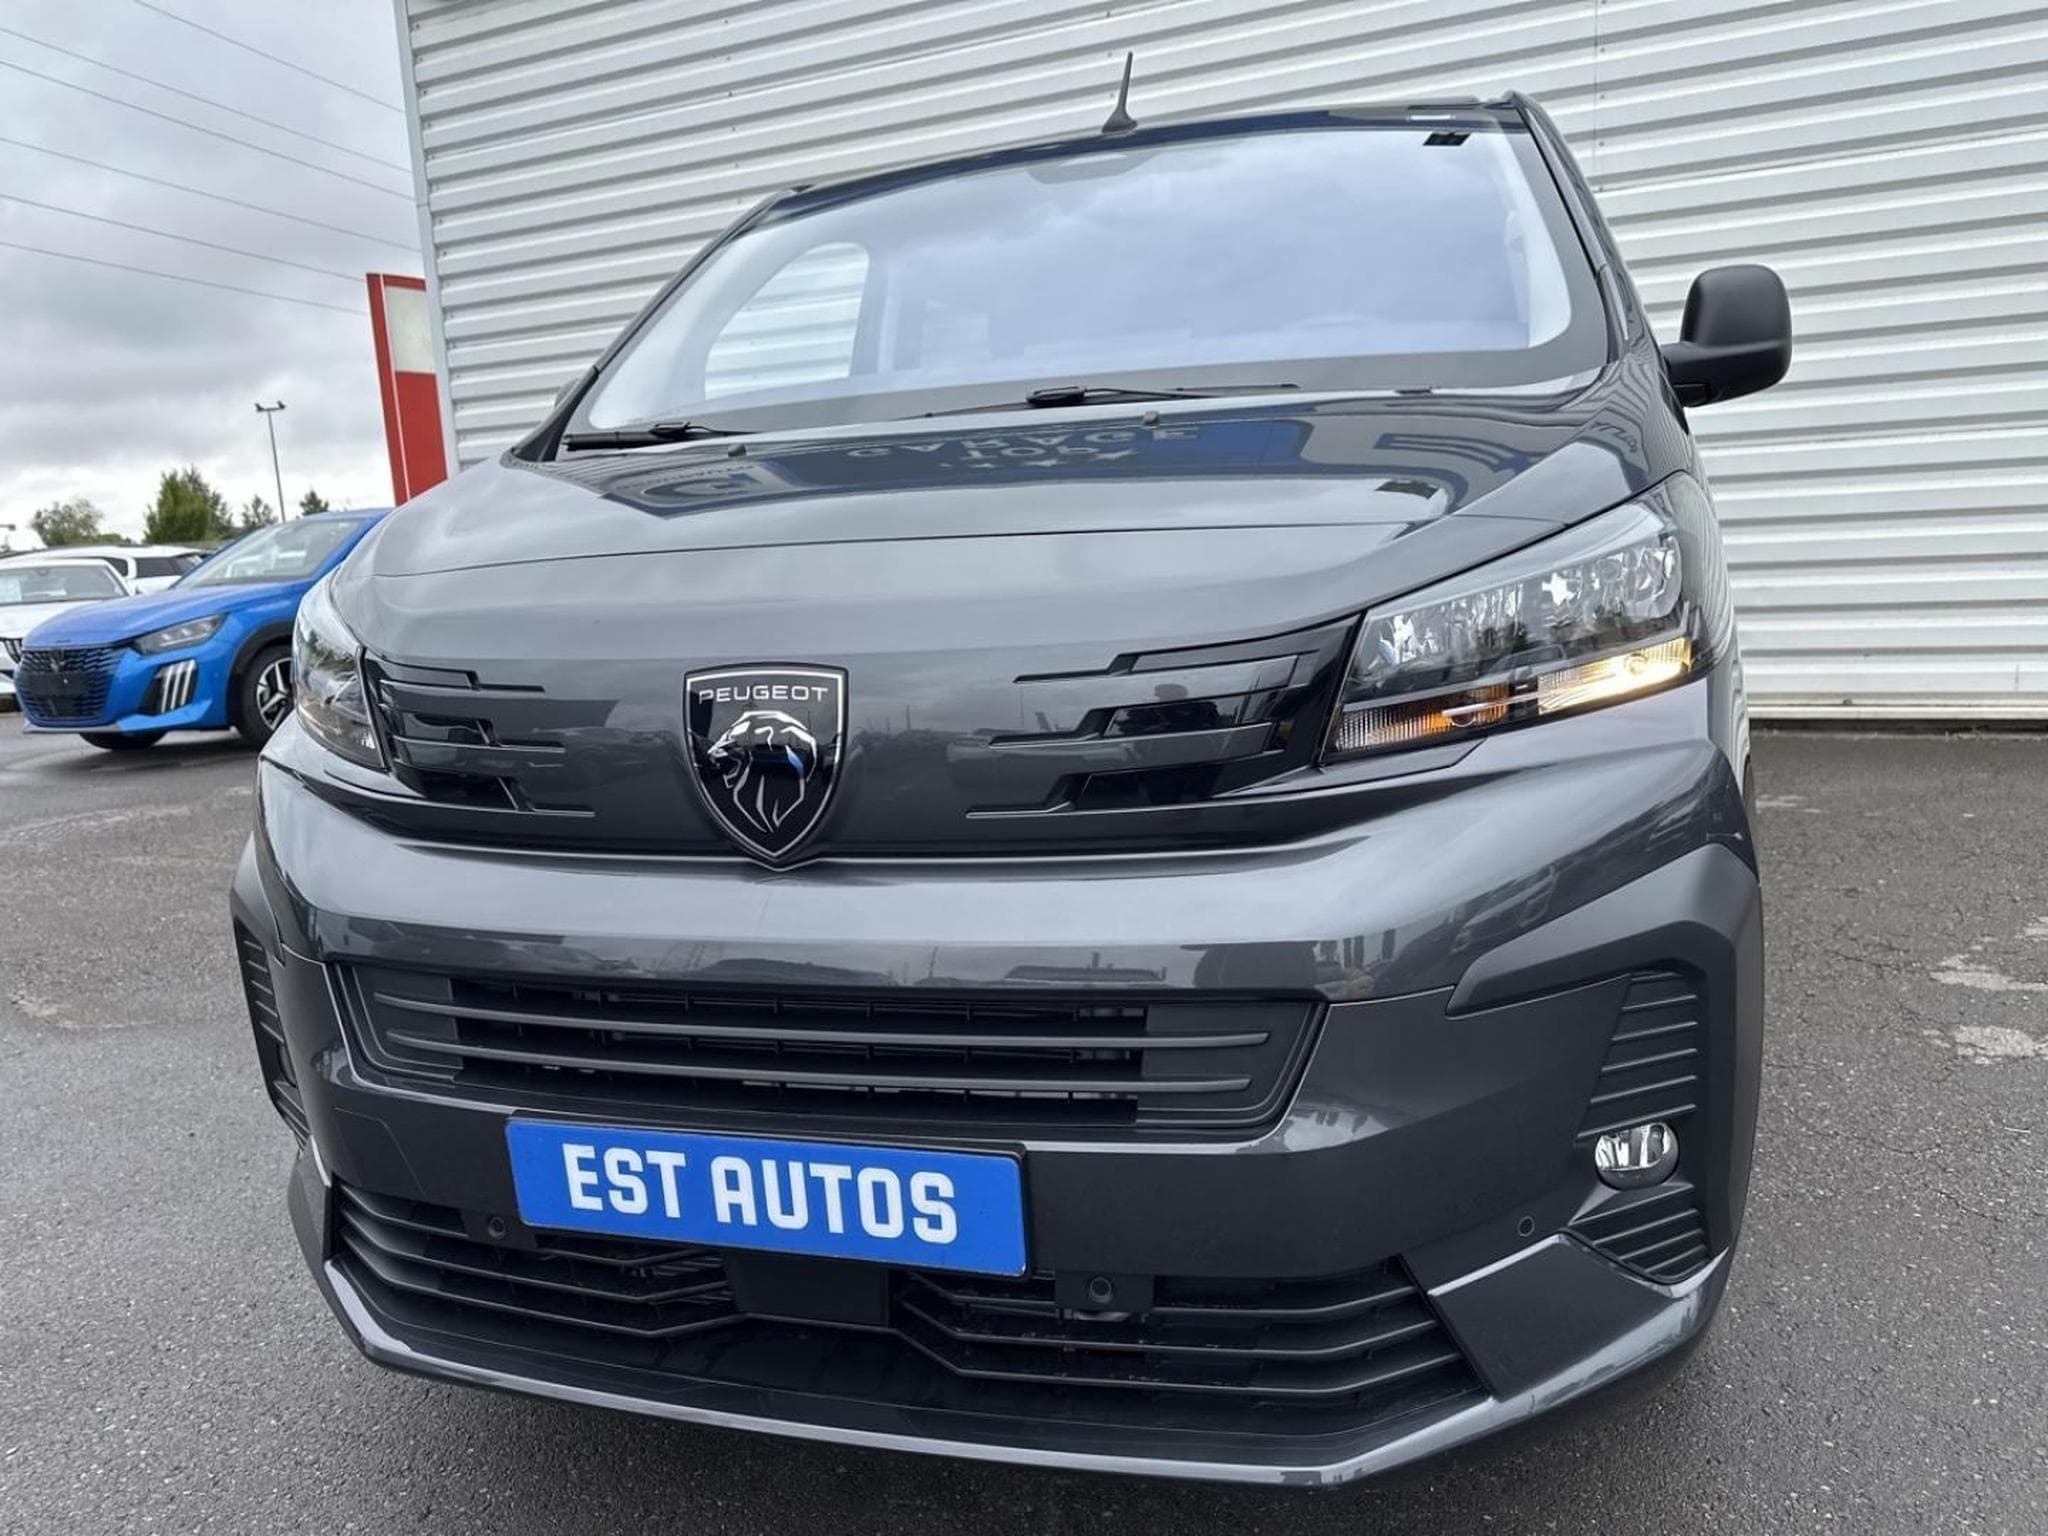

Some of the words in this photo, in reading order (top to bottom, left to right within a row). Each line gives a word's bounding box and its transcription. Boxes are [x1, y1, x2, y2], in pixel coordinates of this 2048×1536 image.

[699, 685, 828, 704] PEUGEOT
[562, 1143, 686, 1218] EST
[710, 1156, 958, 1244] AUTOS
